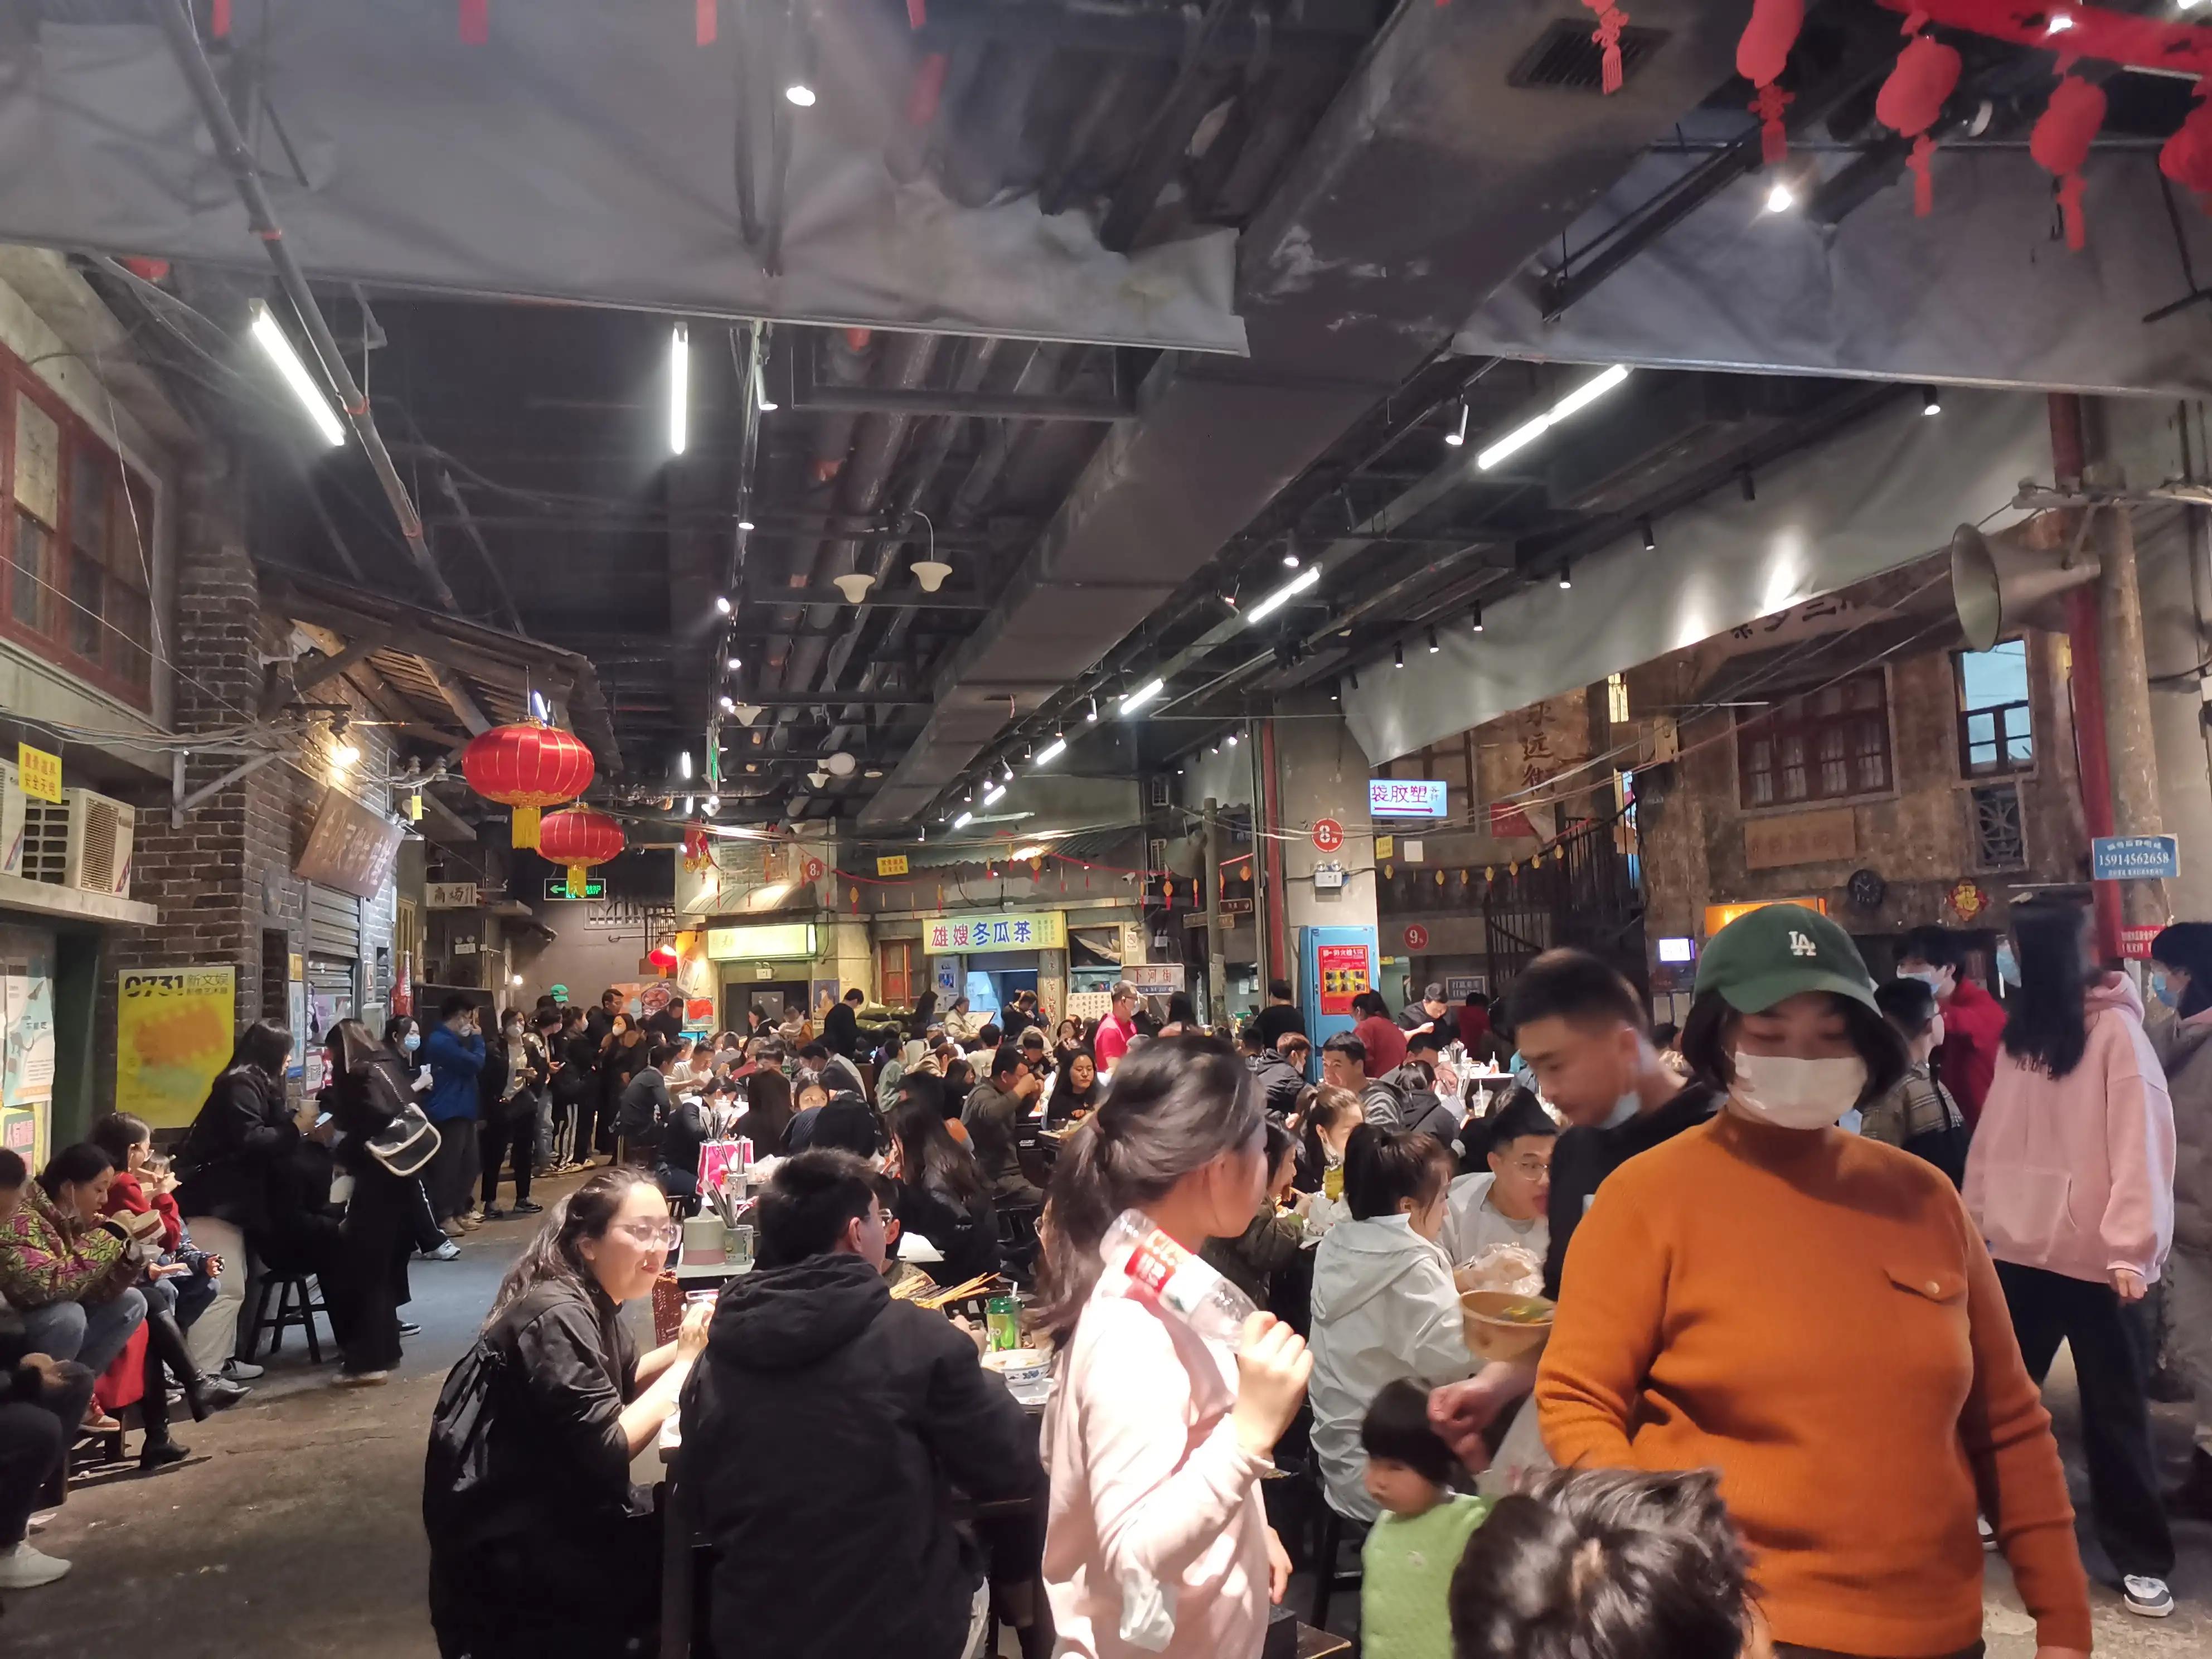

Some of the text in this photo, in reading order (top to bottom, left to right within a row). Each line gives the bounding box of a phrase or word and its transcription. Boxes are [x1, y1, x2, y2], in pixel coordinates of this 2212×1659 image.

[931, 920, 1032, 947] 雄嫂冬瓜茶
[1788, 931, 1817, 956] LA
[125, 973, 229, 997] 0731 新文娱
[1133, 967, 1172, 984] 下河街
